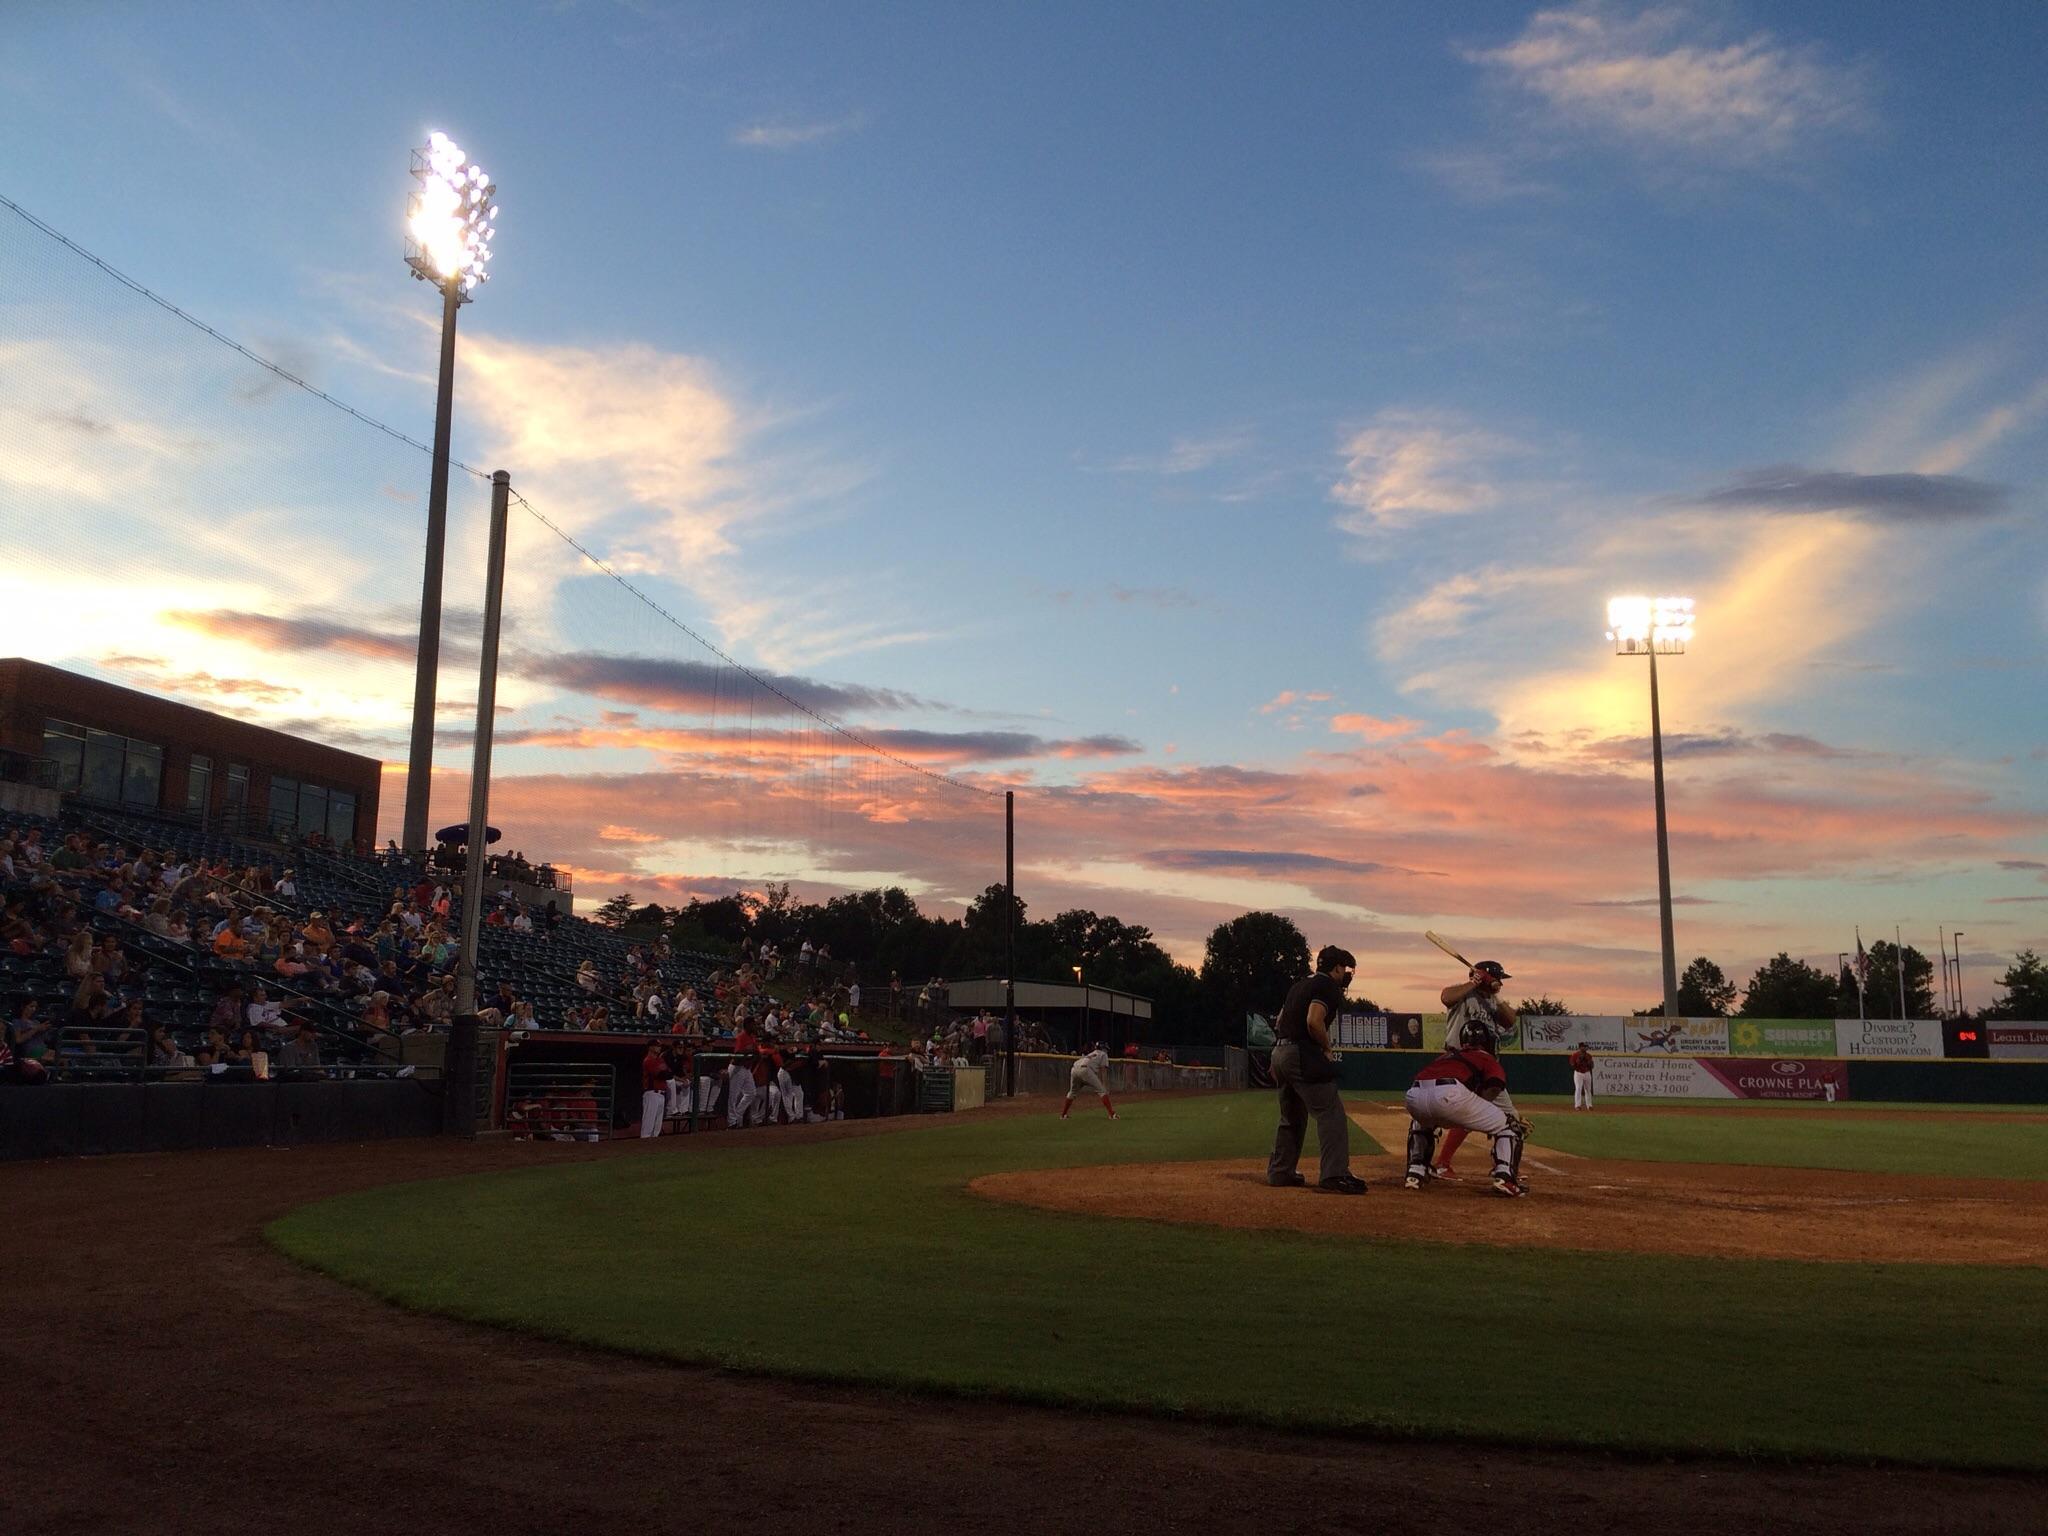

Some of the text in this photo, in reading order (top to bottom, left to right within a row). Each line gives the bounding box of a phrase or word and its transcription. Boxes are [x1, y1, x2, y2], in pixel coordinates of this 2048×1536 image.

[1341, 1014, 1388, 1025] SIGNCO
[1863, 1022, 1914, 1033] DIVORCE?
[1764, 1028, 1832, 1041] SUNBELT
[1862, 1034, 1917, 1045] CUSTODY?
[1993, 1032, 2028, 1042] Learn.
[1662, 1059, 1693, 1069] Home
[1597, 1071, 1624, 1082] Away
[1629, 1072, 1655, 1081] From
[1606, 1083, 1634, 1094] (828)
[1739, 1077, 1790, 1089] CROWNE
